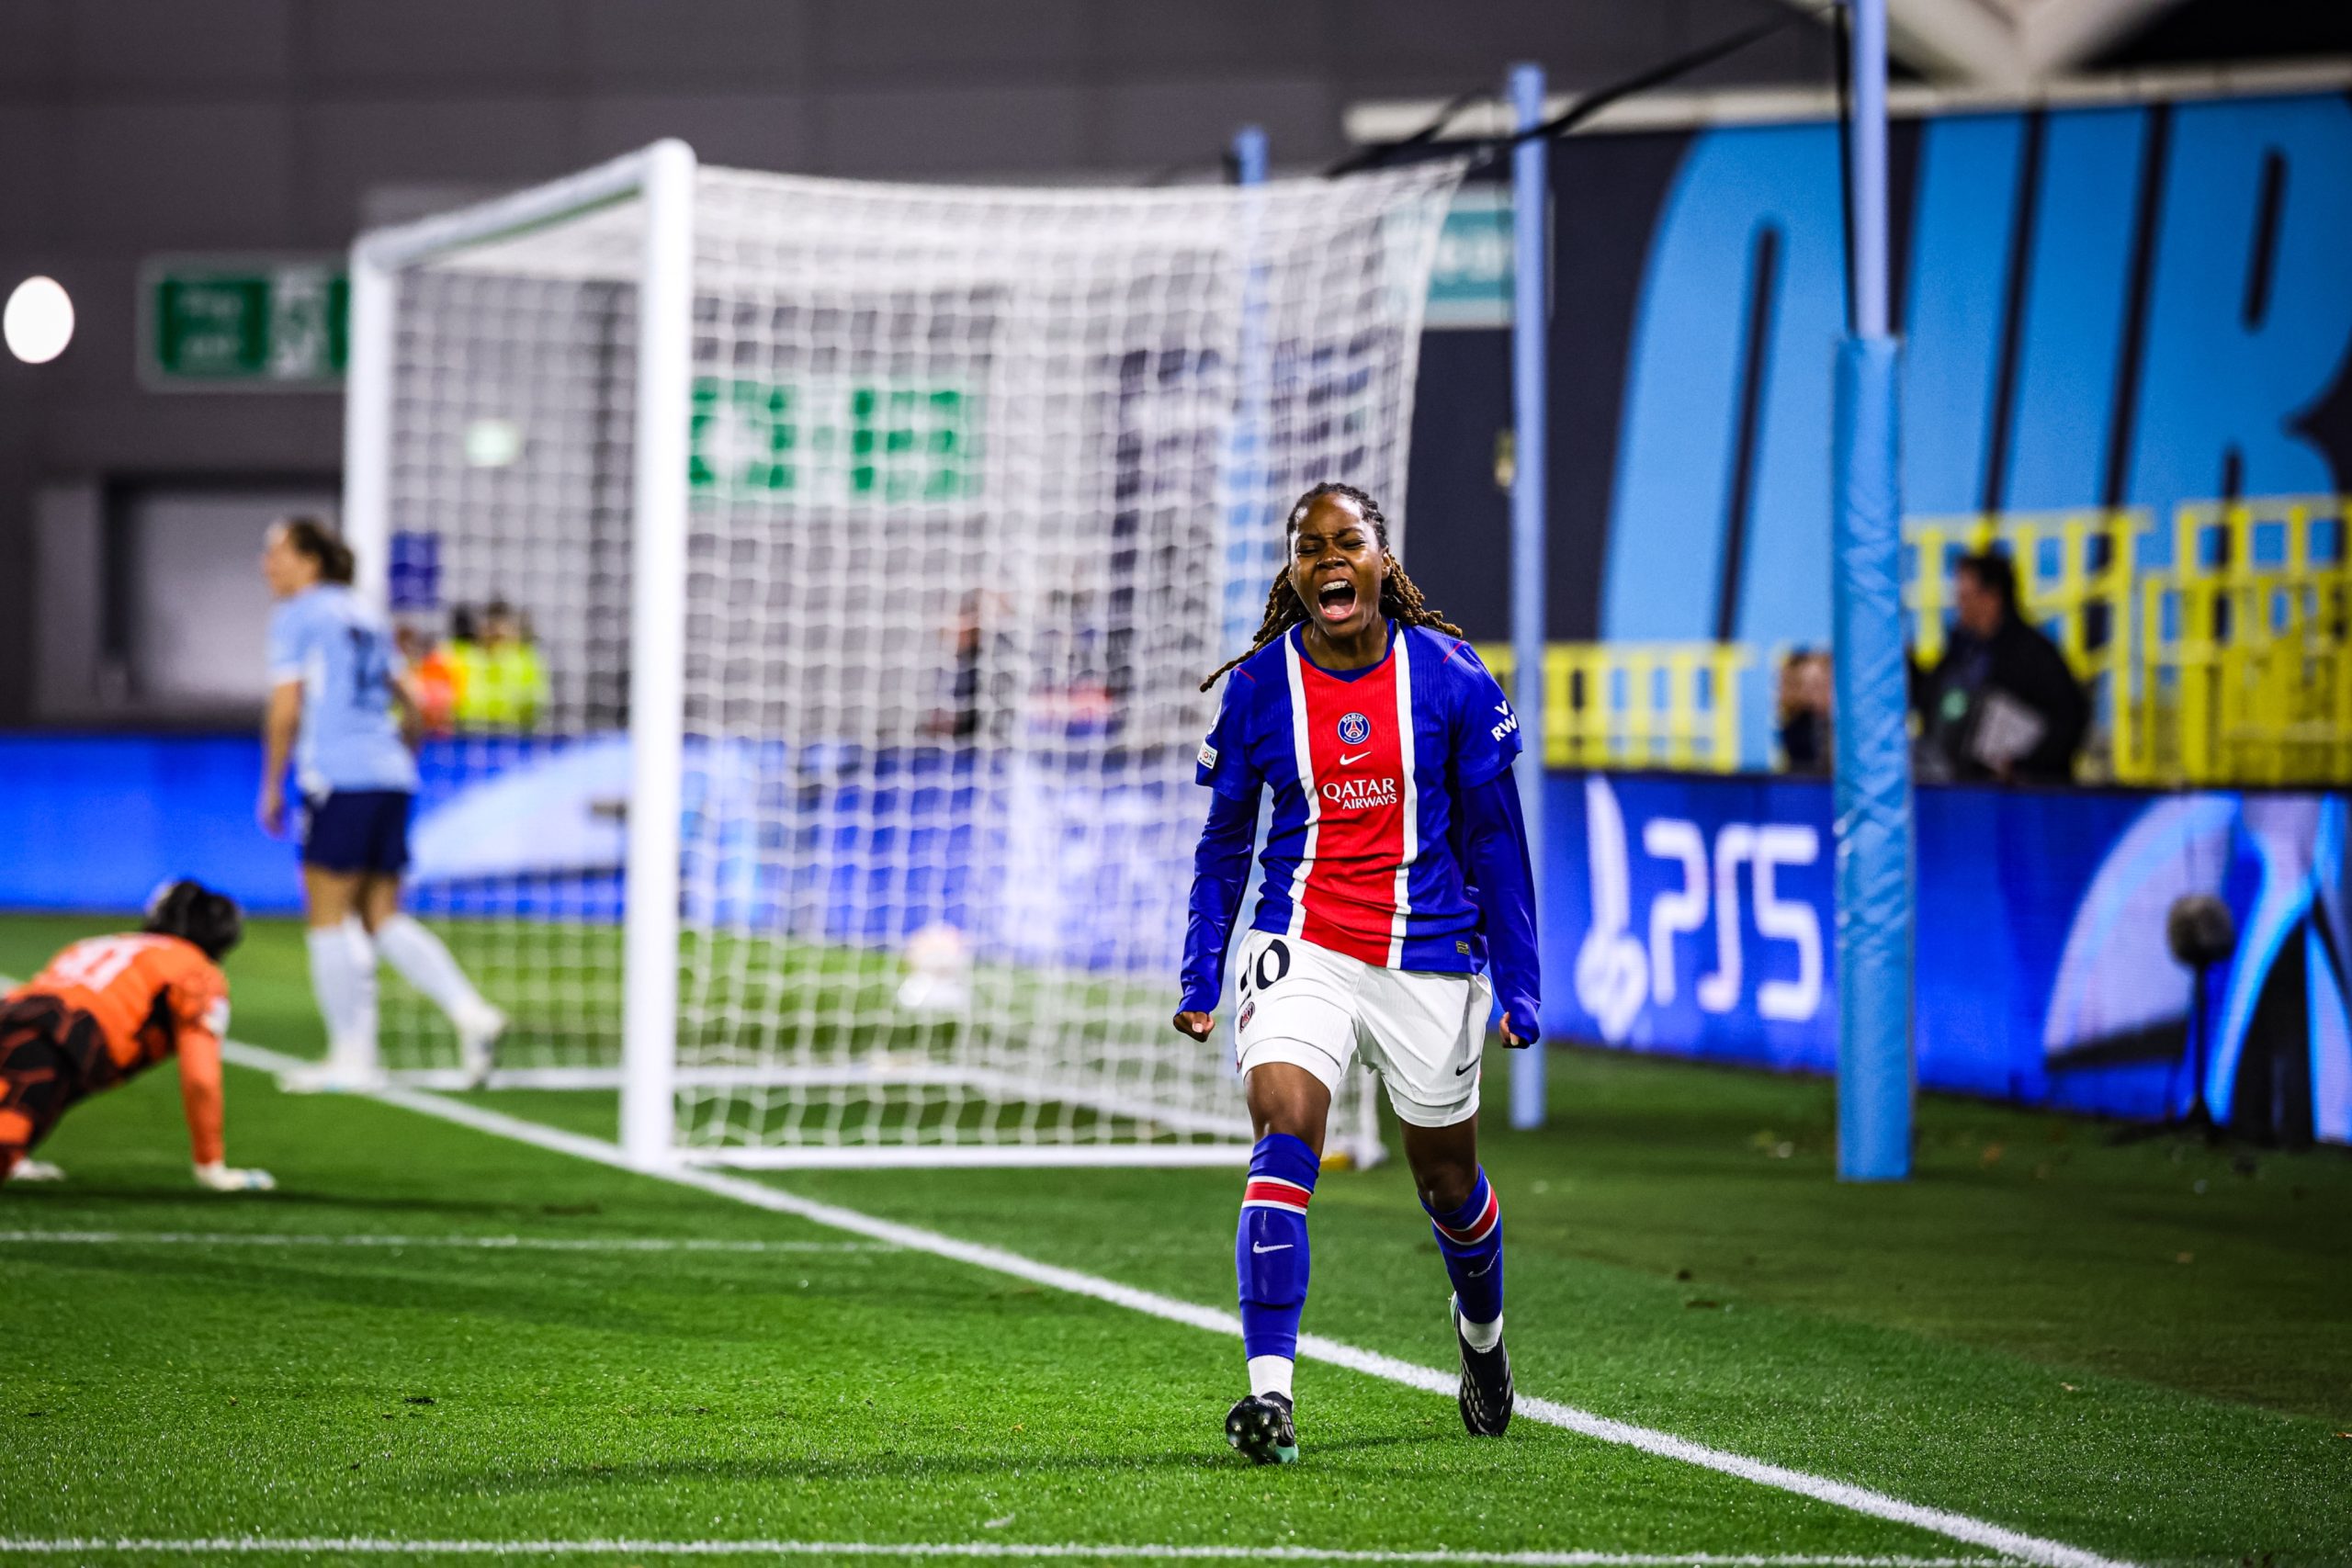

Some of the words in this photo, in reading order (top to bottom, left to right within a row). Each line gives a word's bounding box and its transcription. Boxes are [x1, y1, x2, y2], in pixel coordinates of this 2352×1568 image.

[1342, 714, 1365, 724] PARIS
[1322, 777, 1396, 804] QATAR
[1342, 793, 1397, 810] AIRWAYS
[1643, 816, 1824, 1021] PS5
